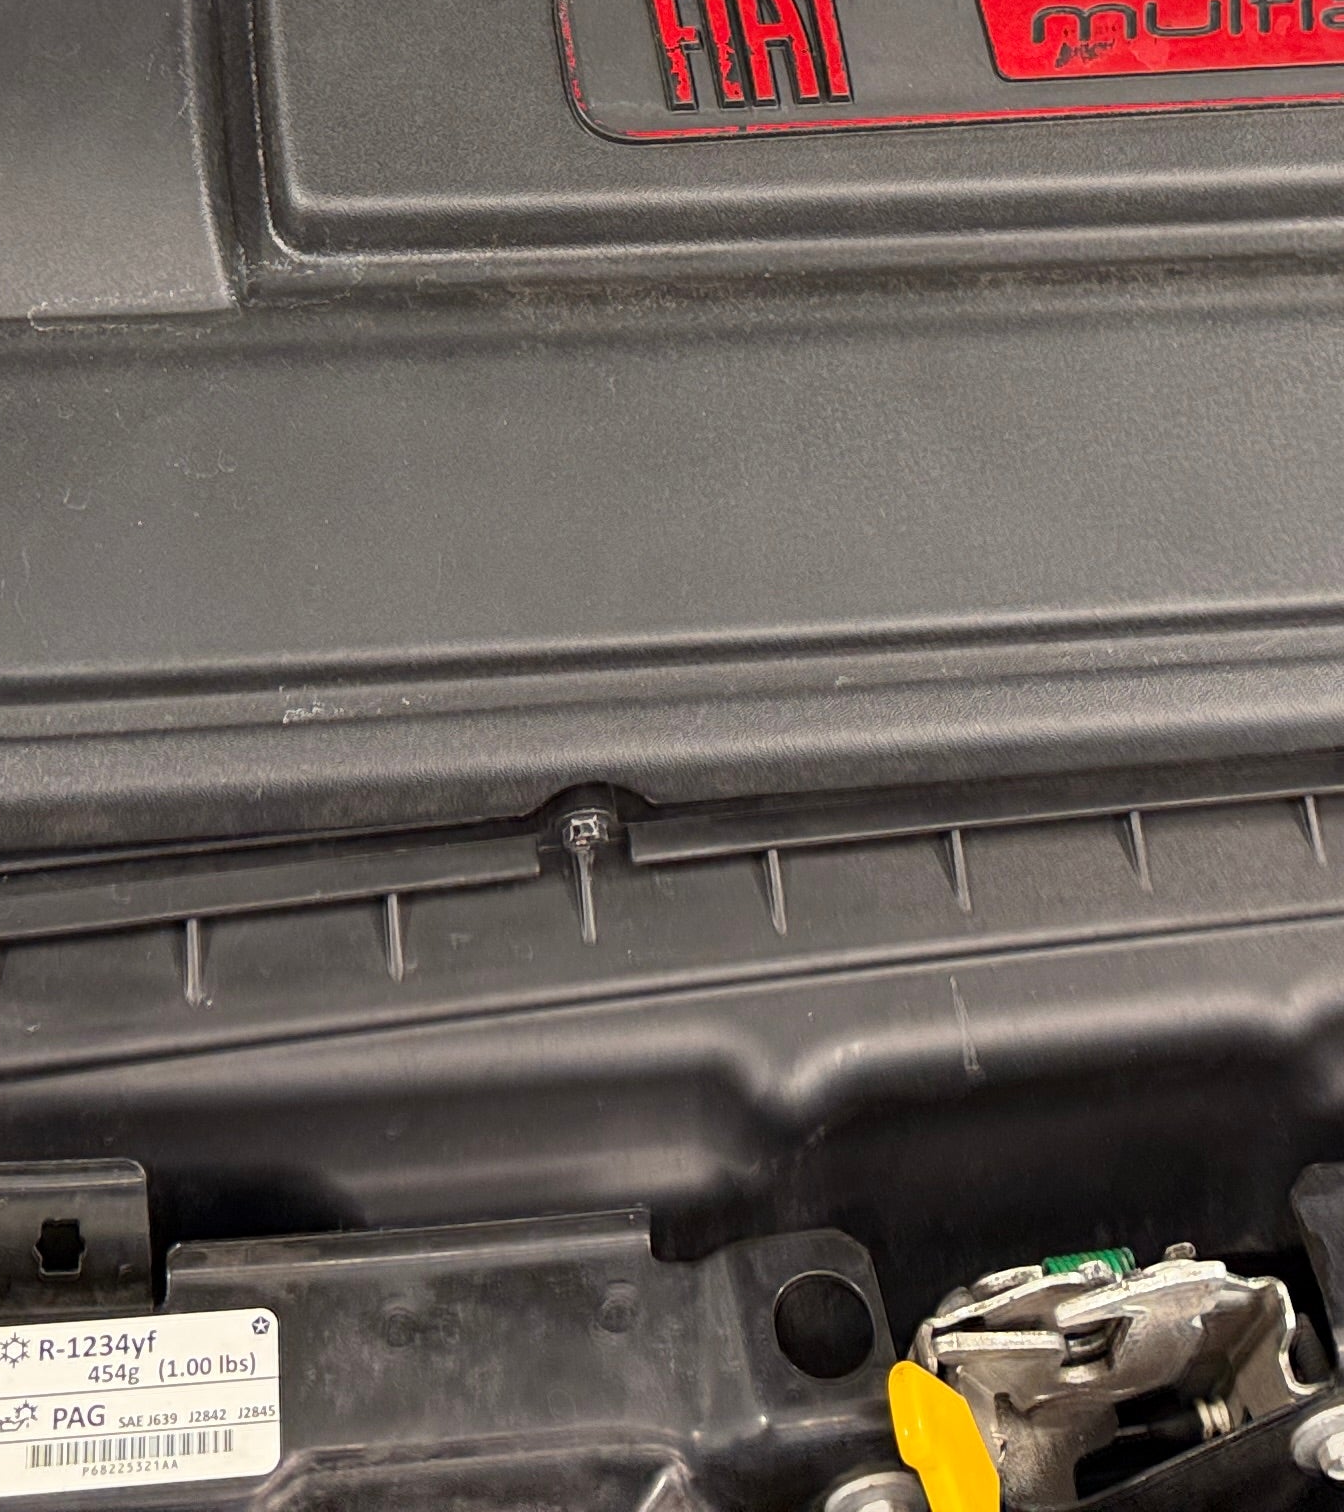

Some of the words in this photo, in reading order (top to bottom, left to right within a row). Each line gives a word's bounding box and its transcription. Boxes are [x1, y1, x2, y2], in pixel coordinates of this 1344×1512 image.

[38, 1329, 158, 1362] R-1234yf
[87, 1364, 141, 1385] 454g
[157, 1356, 213, 1383] (1.00
[218, 1351, 257, 1375] lbs)
[52, 1403, 107, 1431] PAG
[118, 1415, 145, 1429] SAE
[146, 1412, 179, 1428] J639
[188, 1408, 228, 1425] J2842
[237, 1404, 277, 1420] J2845
[81, 1459, 180, 1478] P68225321AA
